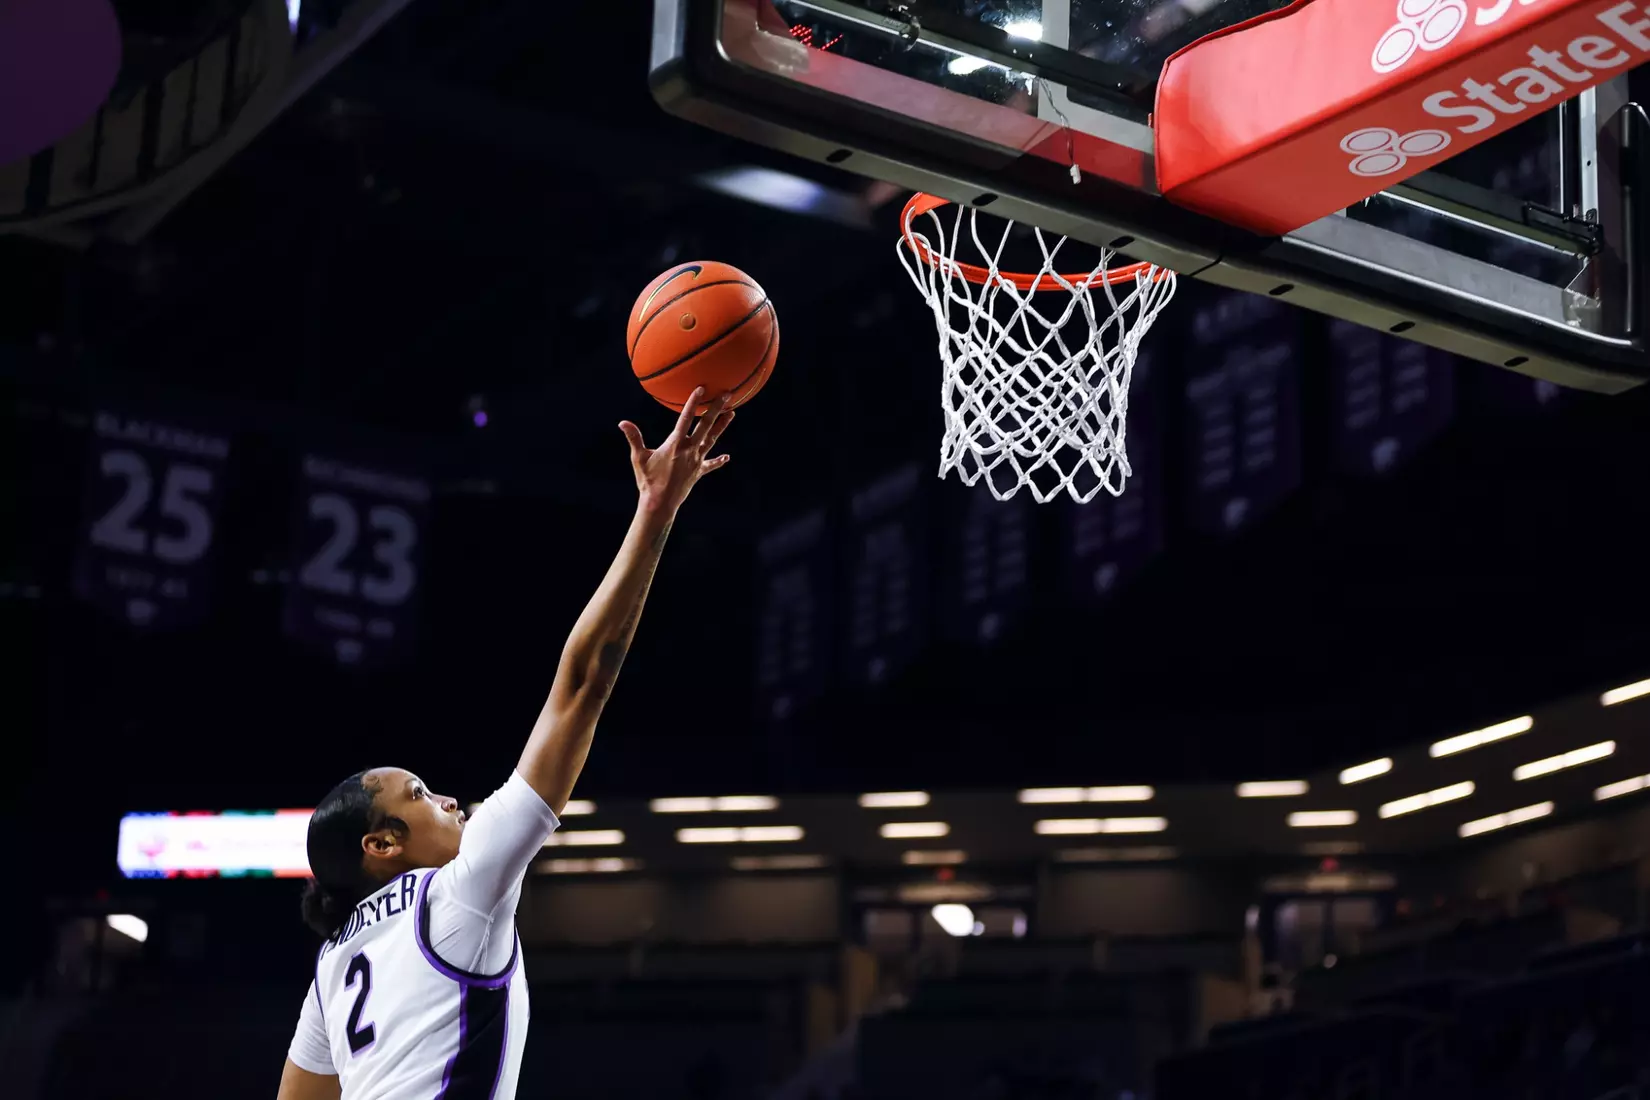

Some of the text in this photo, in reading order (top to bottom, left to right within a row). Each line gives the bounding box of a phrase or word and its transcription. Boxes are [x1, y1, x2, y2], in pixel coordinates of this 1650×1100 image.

[90, 449, 214, 563] 25
[299, 491, 417, 606] 23
[344, 950, 376, 1059] 2
